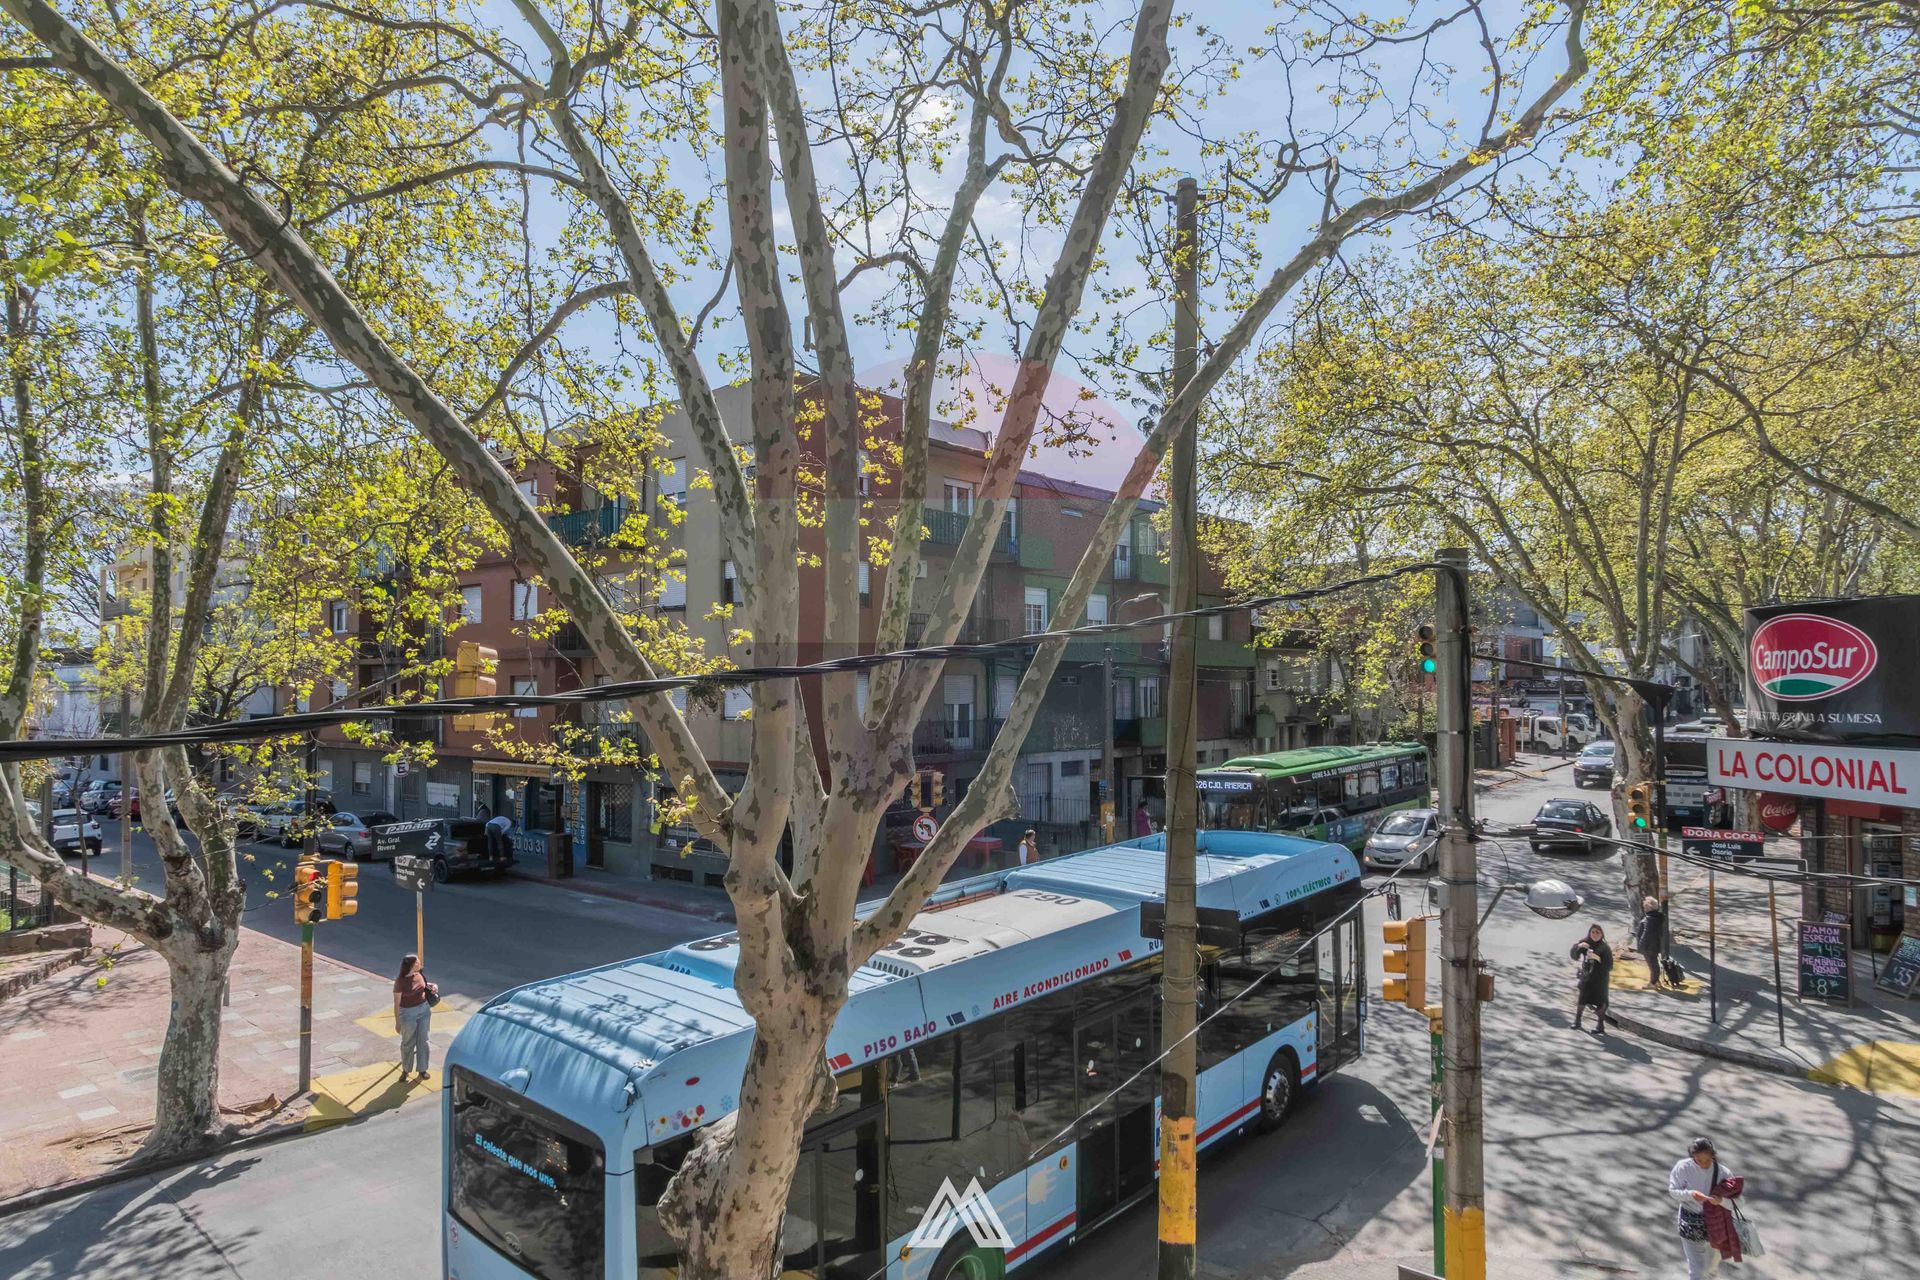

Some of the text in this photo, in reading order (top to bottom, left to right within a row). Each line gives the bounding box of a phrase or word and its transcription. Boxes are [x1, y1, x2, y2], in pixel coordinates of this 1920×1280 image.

[1755, 642, 1858, 674] CampoSur
[1828, 713, 1843, 723] SU
[1846, 713, 1882, 724] MESA
[1719, 750, 1907, 795] LA COLONIAL
[1224, 782, 1251, 790] AMERICA
[1687, 828, 1757, 841] DOÑA COCA
[1015, 891, 1081, 906] 290
[1802, 934, 1844, 945] ESPECIAL
[993, 958, 1109, 1010] AIRE ACONDICIONADO
[864, 1021, 936, 1058] PISO BAJO
[475, 1133, 483, 1146] El
[483, 1140, 508, 1161] celeste
[508, 1155, 522, 1170] que
[523, 1163, 537, 1178] nos
